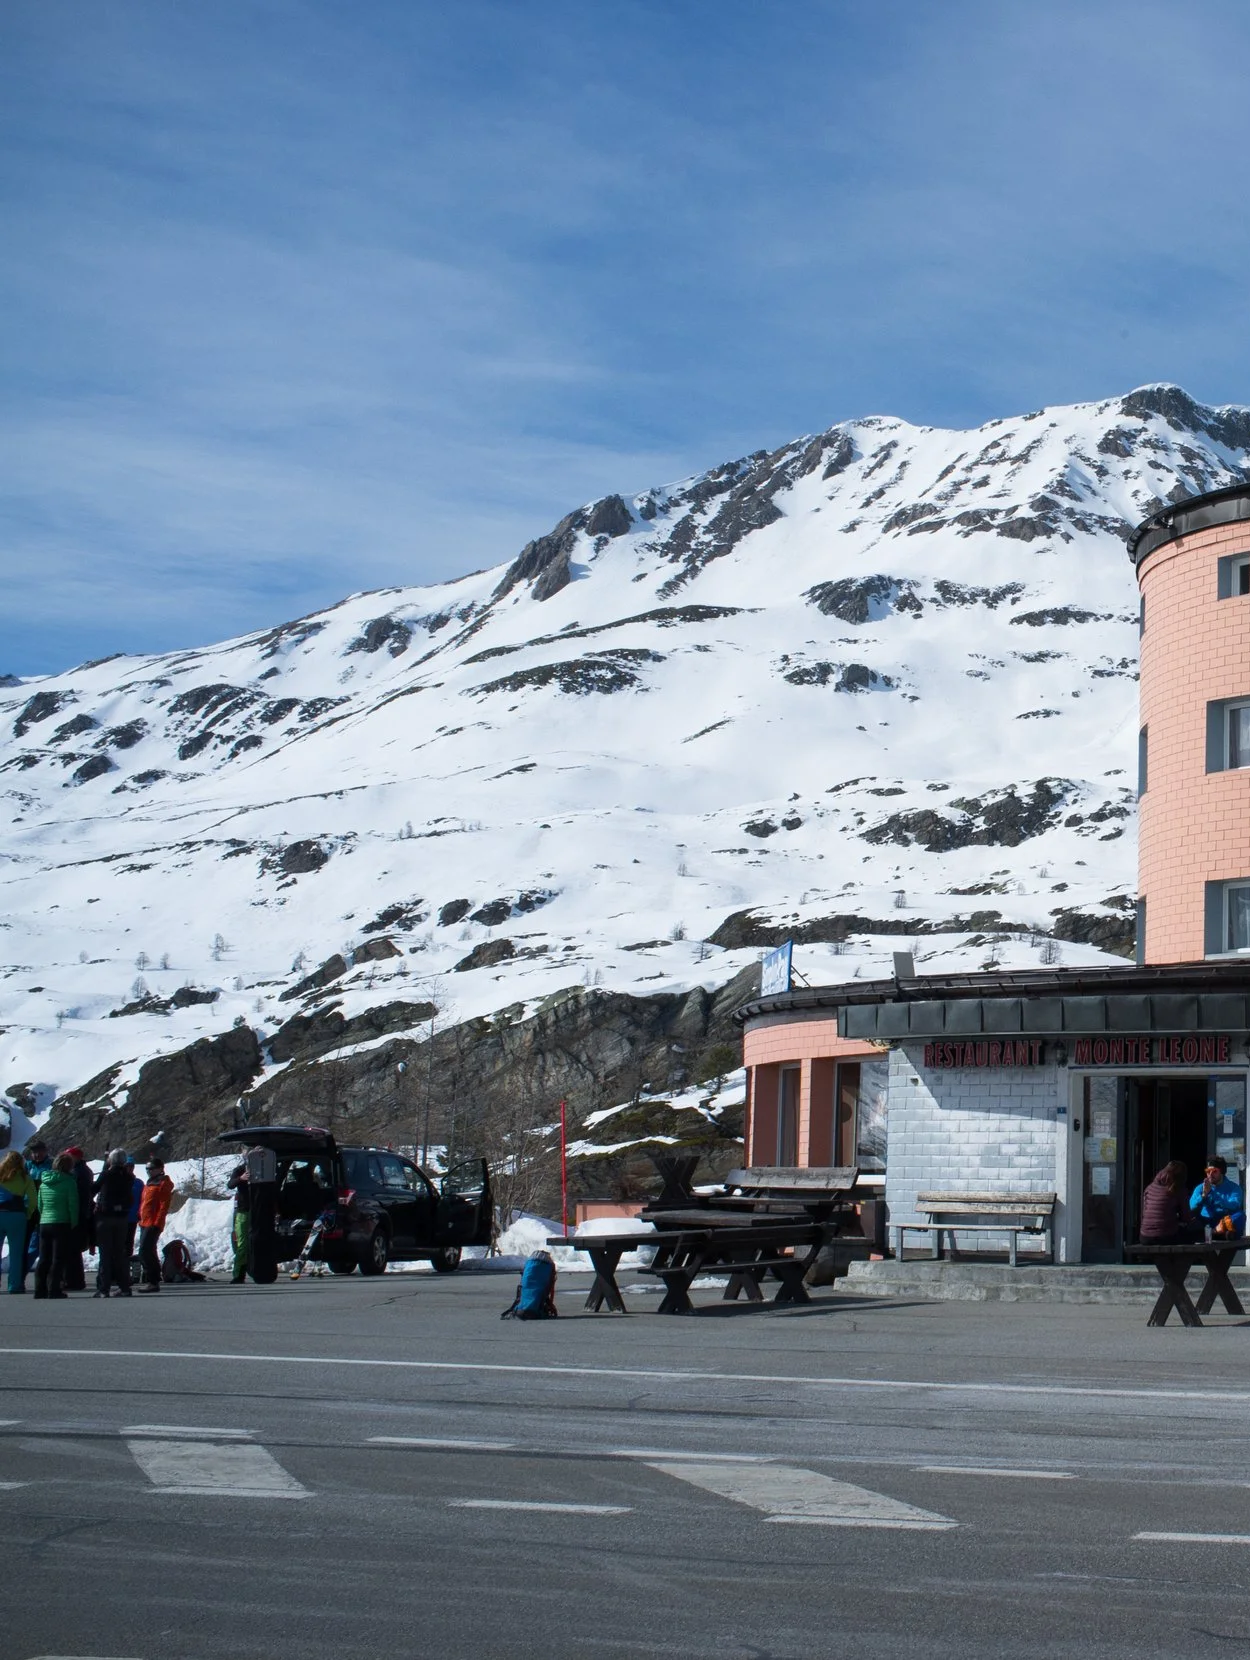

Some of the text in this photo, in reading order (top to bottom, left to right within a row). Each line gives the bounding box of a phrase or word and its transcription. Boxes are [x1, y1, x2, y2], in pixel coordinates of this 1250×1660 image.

[924, 1039, 1042, 1068] RESTAURANT
[1075, 1038, 1149, 1065] MONTE
[1159, 1036, 1229, 1064] LEONE
